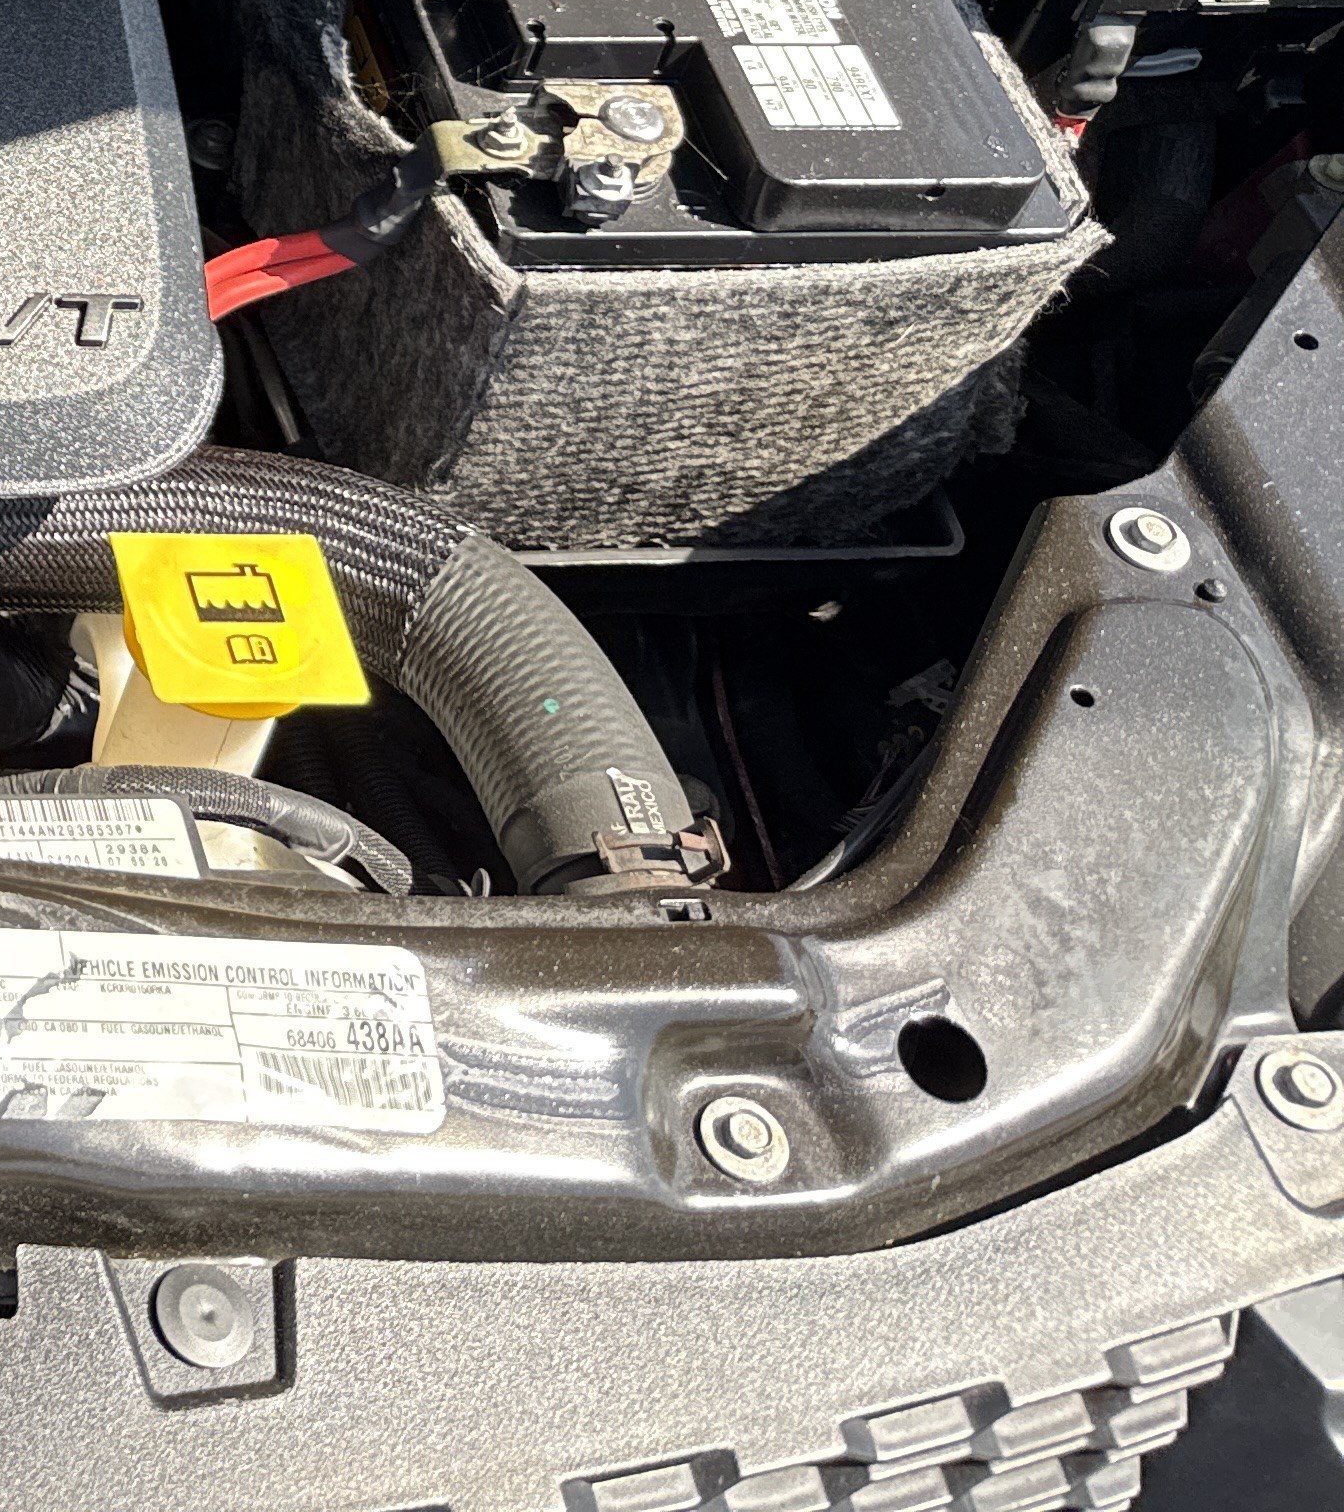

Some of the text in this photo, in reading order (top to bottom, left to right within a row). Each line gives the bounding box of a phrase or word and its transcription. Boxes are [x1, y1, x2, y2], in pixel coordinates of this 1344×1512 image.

[638, 779, 666, 835] MEXICO
[142, 961, 219, 982] EMISSION
[226, 965, 299, 987] CONTROL
[286, 1021, 426, 1054] 68406 438AA
[48, 1075, 89, 1085] FEDERAL
